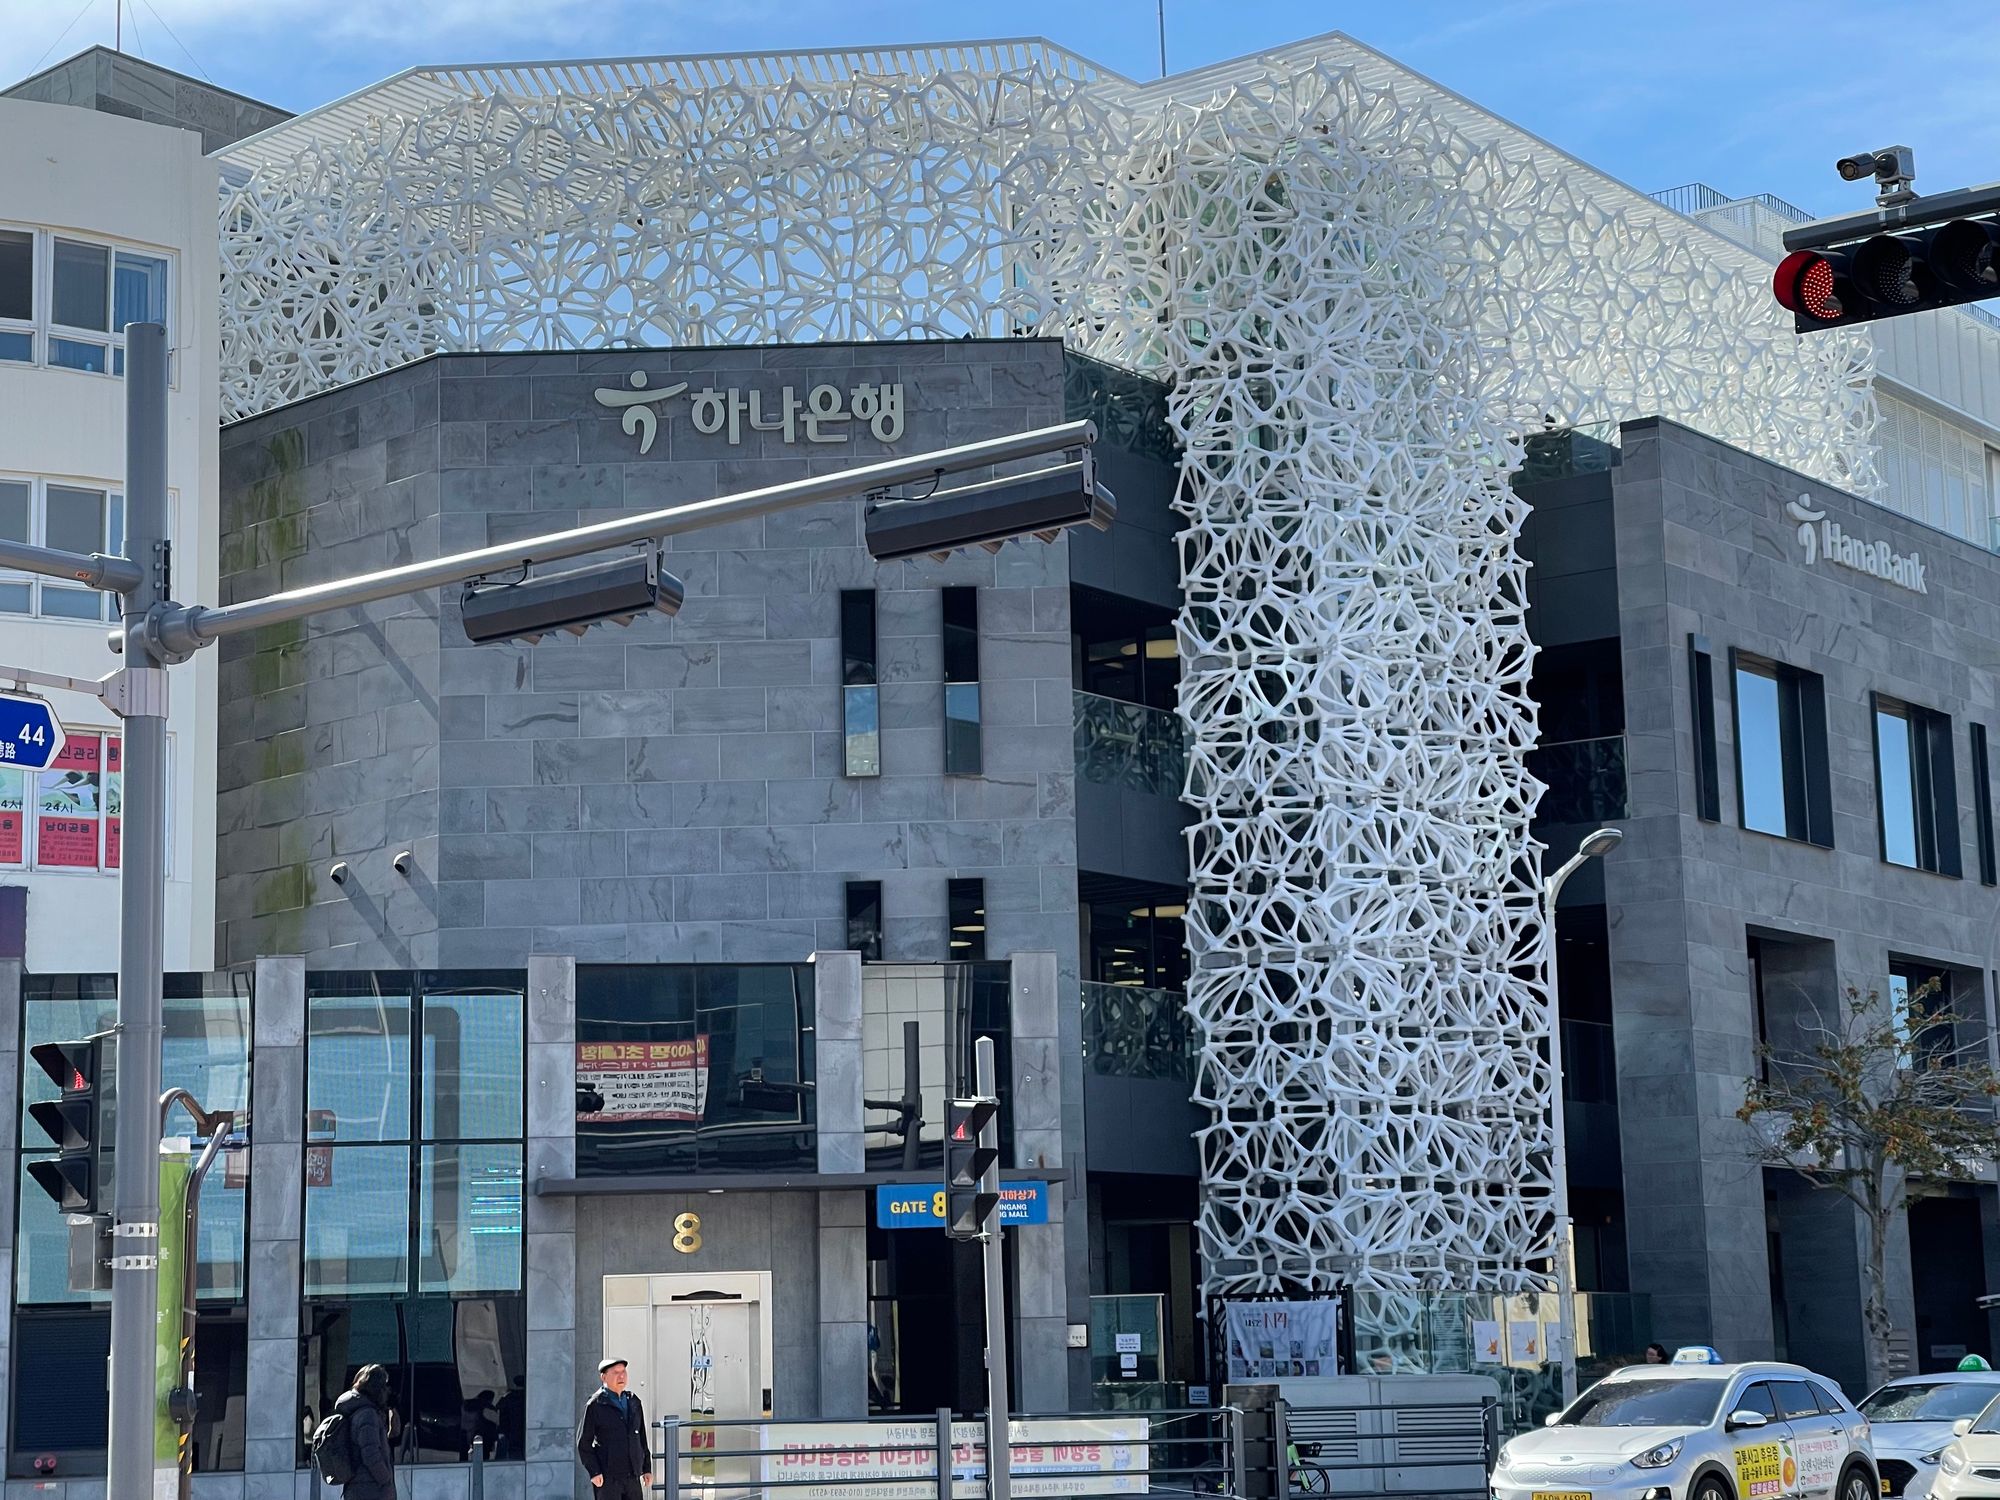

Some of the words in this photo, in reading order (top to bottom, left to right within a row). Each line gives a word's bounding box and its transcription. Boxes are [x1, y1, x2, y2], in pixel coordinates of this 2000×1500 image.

[690, 383, 905, 445] 하나은행
[1821, 519, 1929, 595] HanaBank
[18, 723, 45, 747] 44
[46, 802, 73, 814] 24시
[890, 1201, 927, 1214] GATE
[932, 1191, 946, 1218] 8
[672, 1211, 703, 1254] 8
